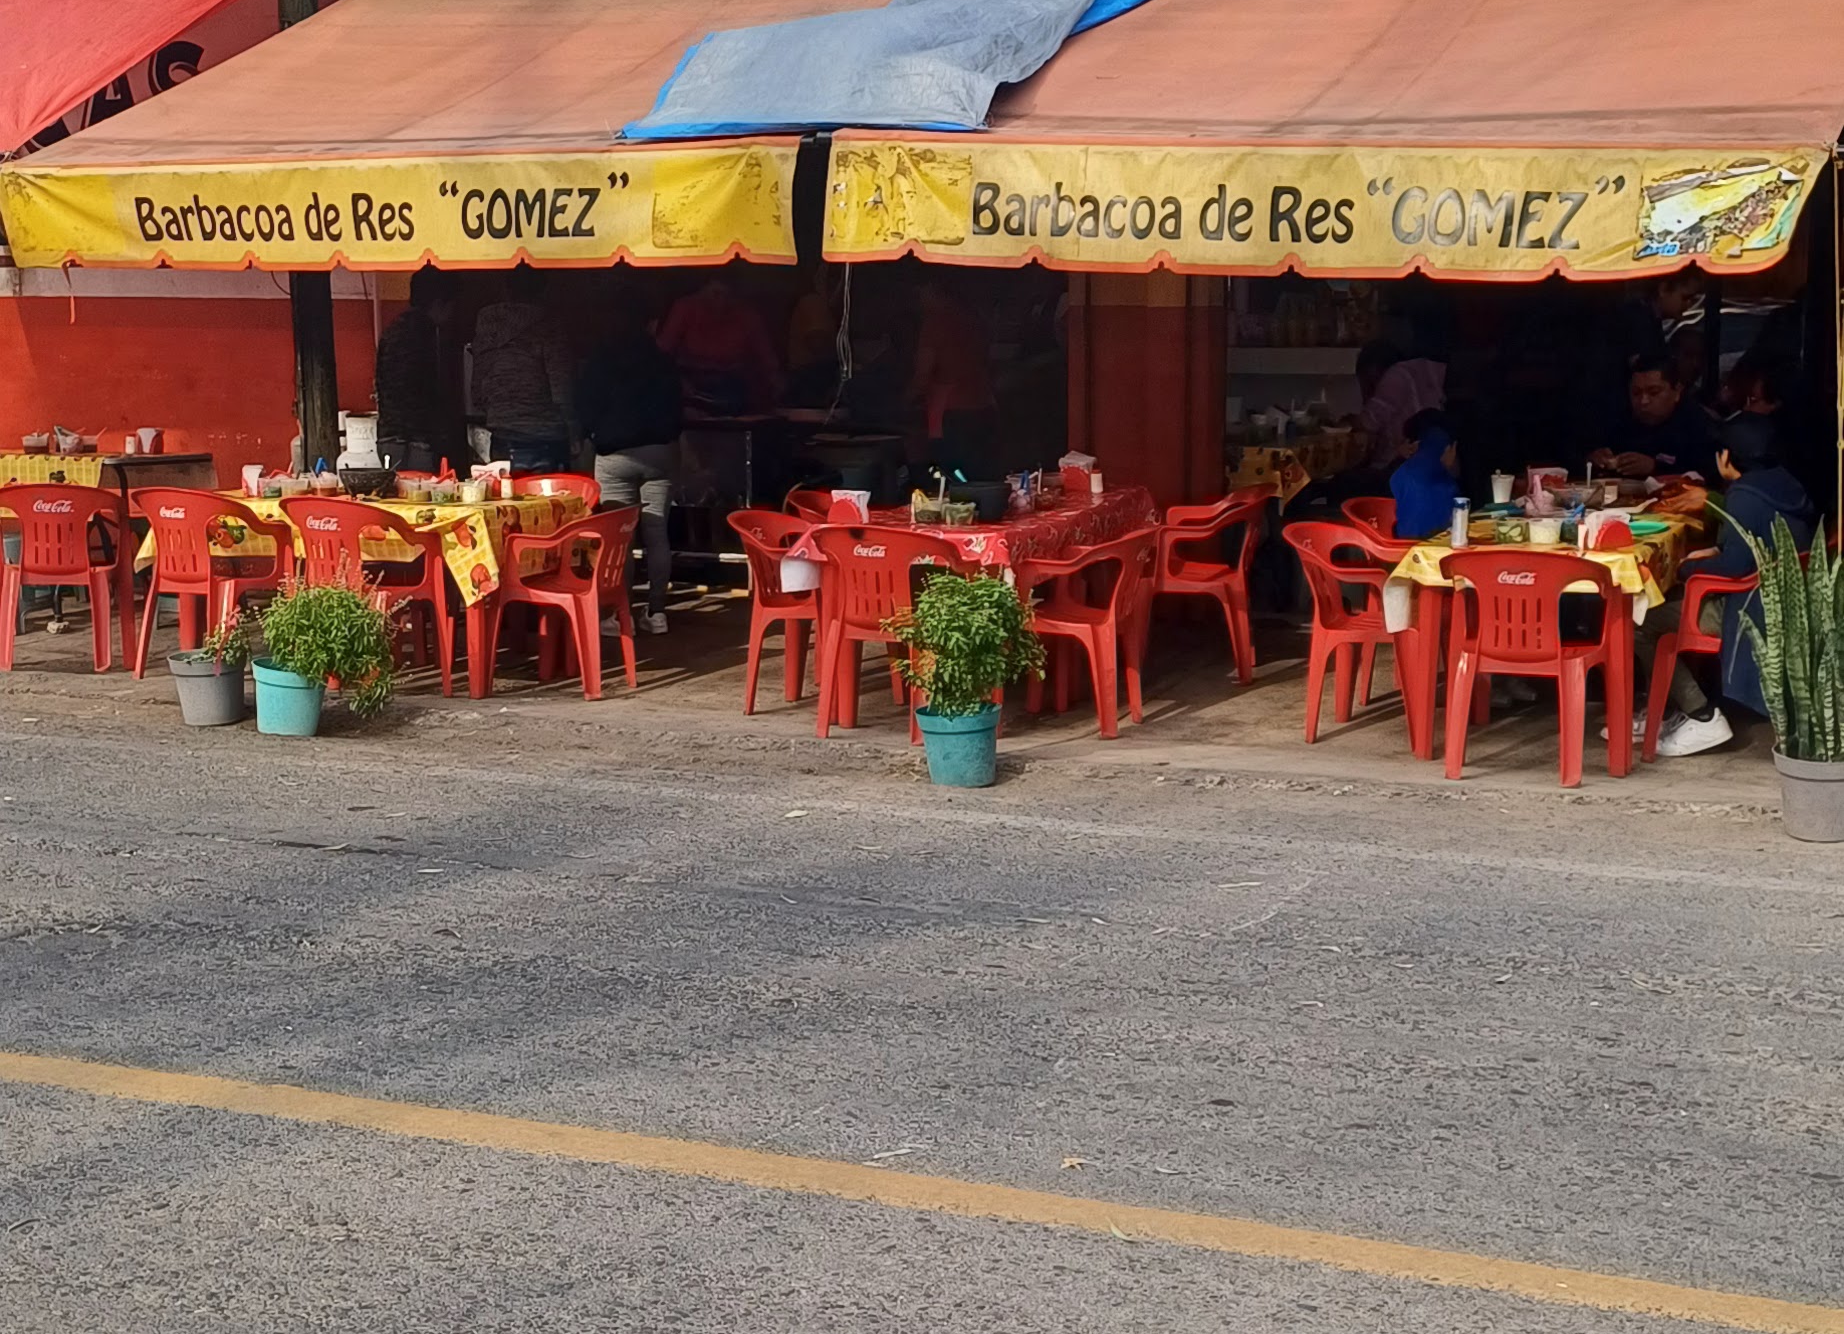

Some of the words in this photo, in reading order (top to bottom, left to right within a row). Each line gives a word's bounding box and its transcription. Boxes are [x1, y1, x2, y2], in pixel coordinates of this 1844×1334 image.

[134, 194, 295, 242] Barbacoa
[304, 191, 342, 241] de
[351, 192, 415, 242] Res
[439, 171, 630, 240] “GOMEZ”
[972, 181, 1182, 240] Barbacoa
[1199, 183, 1254, 242] de
[1269, 185, 1355, 244] Res
[1366, 175, 1626, 249] “GOMEZ”
